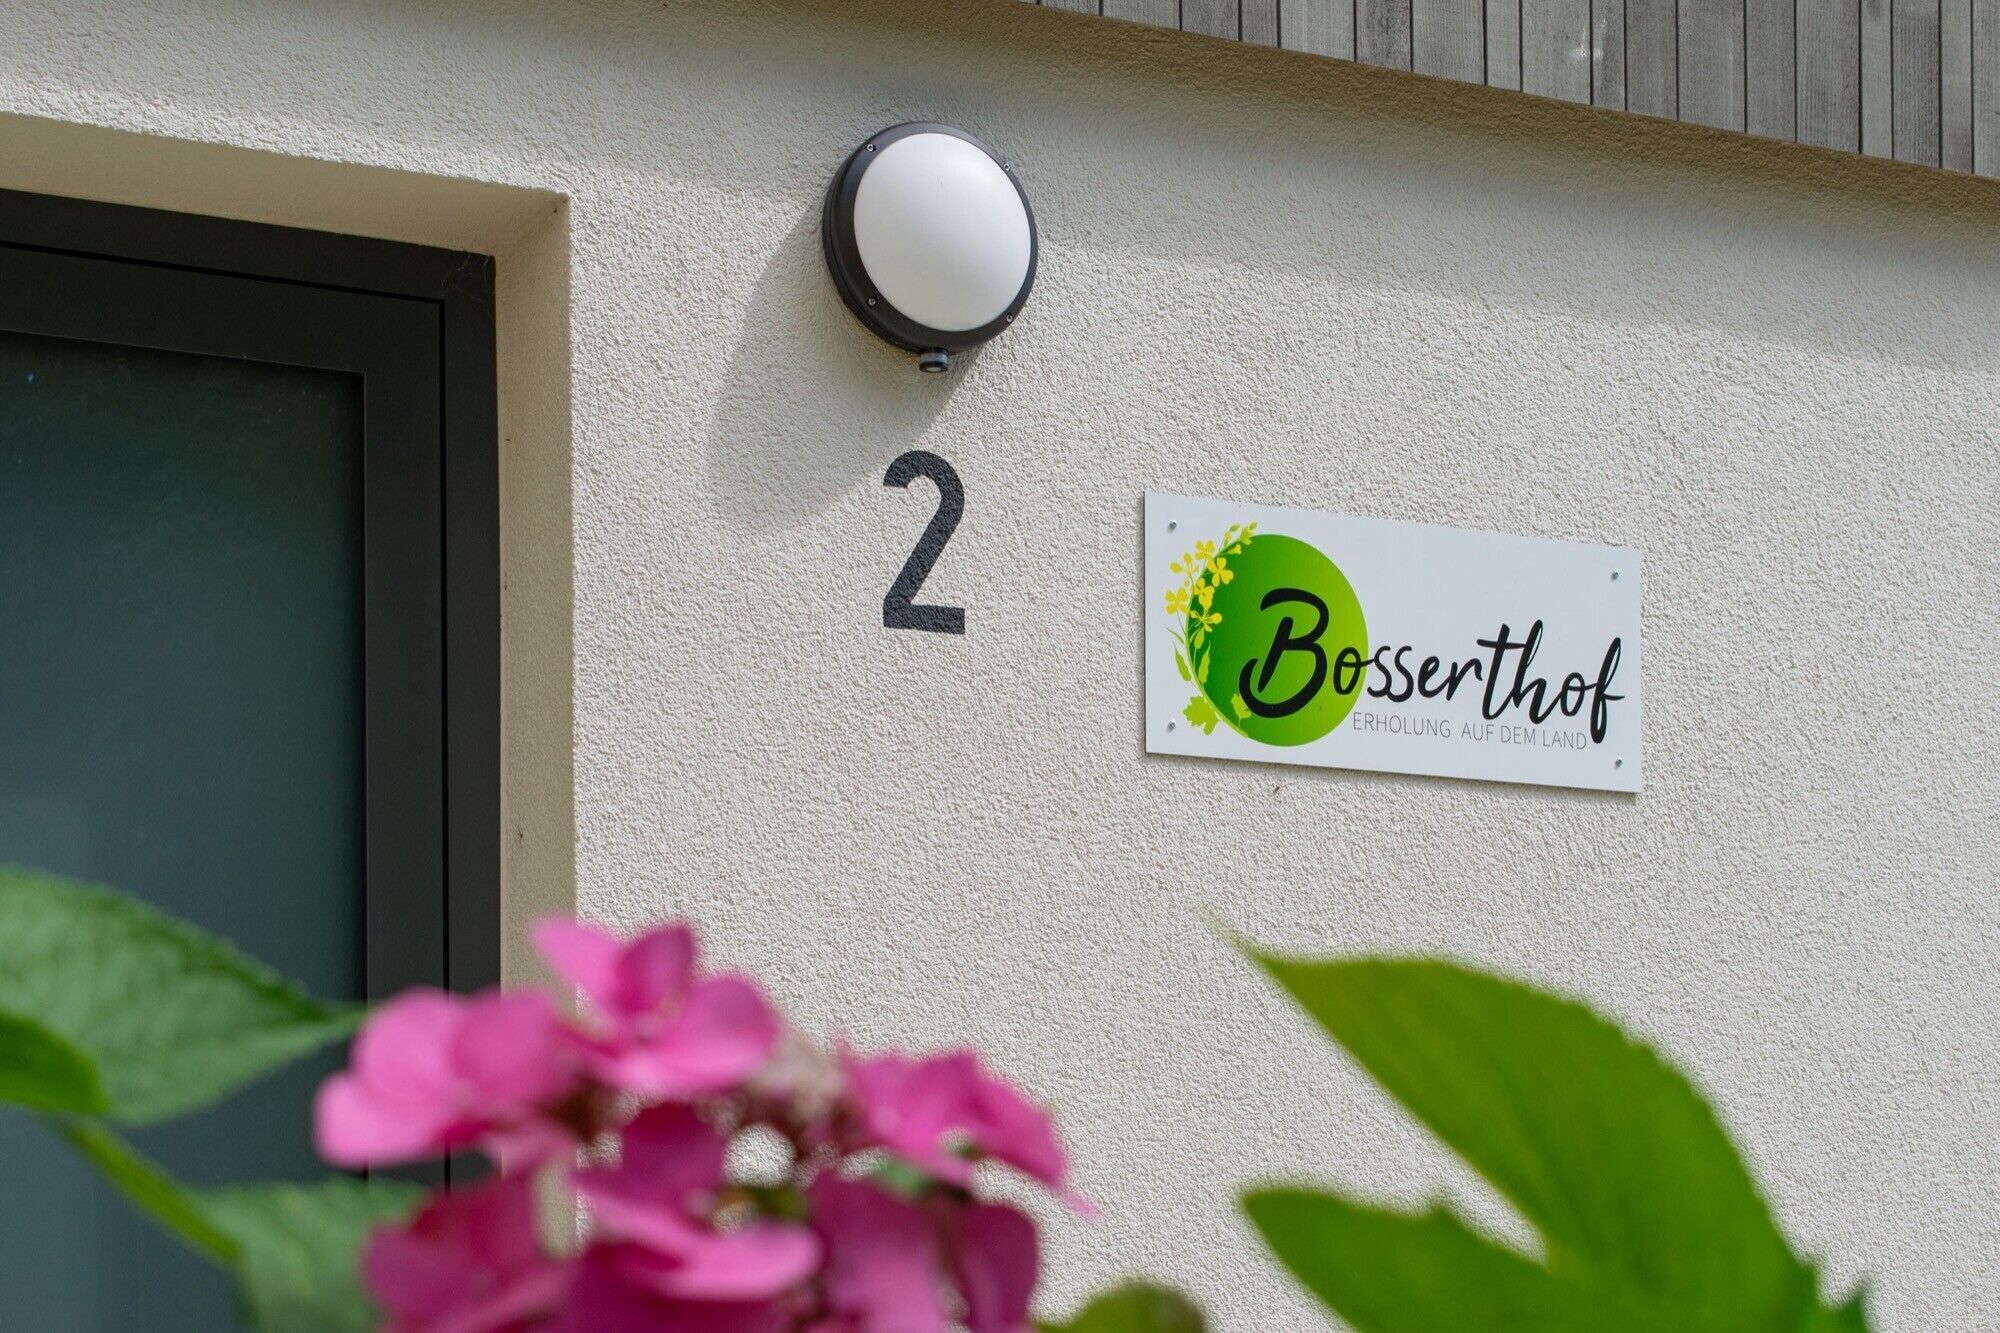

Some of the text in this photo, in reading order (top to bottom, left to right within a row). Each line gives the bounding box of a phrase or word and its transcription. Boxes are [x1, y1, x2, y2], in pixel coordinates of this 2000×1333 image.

[883, 450, 965, 634] 2
[1239, 588, 1625, 744] Bosserthof
[1352, 712, 1588, 750] ERHOLUNG AUF DEM LAND
